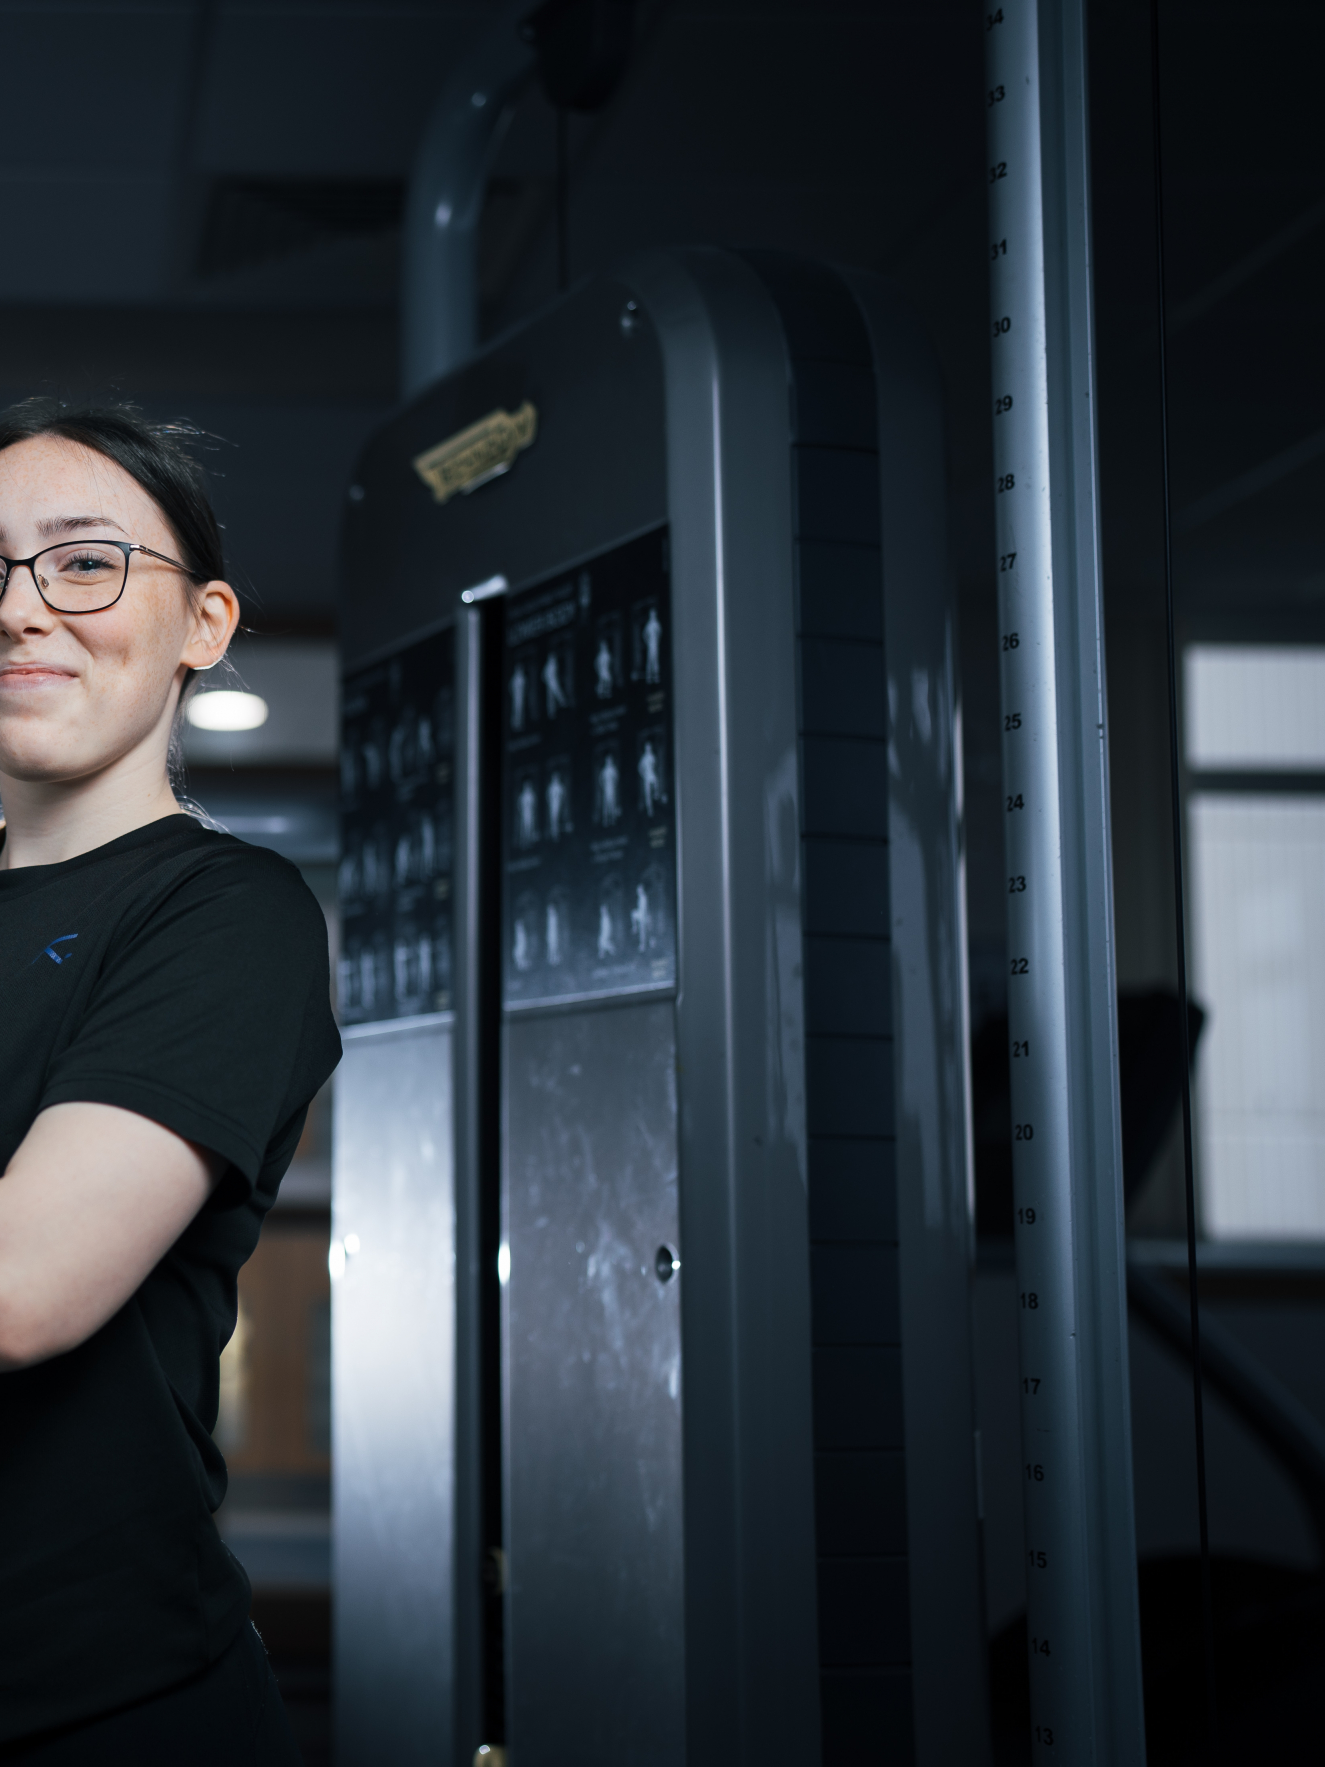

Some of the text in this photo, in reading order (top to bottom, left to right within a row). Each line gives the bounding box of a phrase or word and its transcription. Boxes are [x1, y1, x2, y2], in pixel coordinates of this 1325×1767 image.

[986, 8, 1004, 32] 34
[987, 85, 1005, 108] 33
[989, 162, 1007, 184] 32
[991, 239, 1007, 260] 31
[993, 317, 1011, 338] 30
[995, 395, 1013, 415] 29
[997, 474, 1015, 493] 28
[999, 553, 1017, 572] 27
[1002, 633, 1020, 651] 26
[1005, 713, 1022, 731] 25
[1007, 794, 1024, 812] 24
[1009, 876, 1027, 893] 23
[1011, 958, 1029, 975] 22
[1013, 1040, 1029, 1058] 21
[1015, 1124, 1033, 1141] 20
[1017, 1208, 1036, 1225] 19
[1020, 1292, 1038, 1310] 18
[1023, 1377, 1041, 1395] 17
[1025, 1464, 1044, 1481] 16
[1029, 1550, 1047, 1569] 15
[1032, 1637, 1051, 1657] 14
[1035, 1725, 1054, 1746] 13
